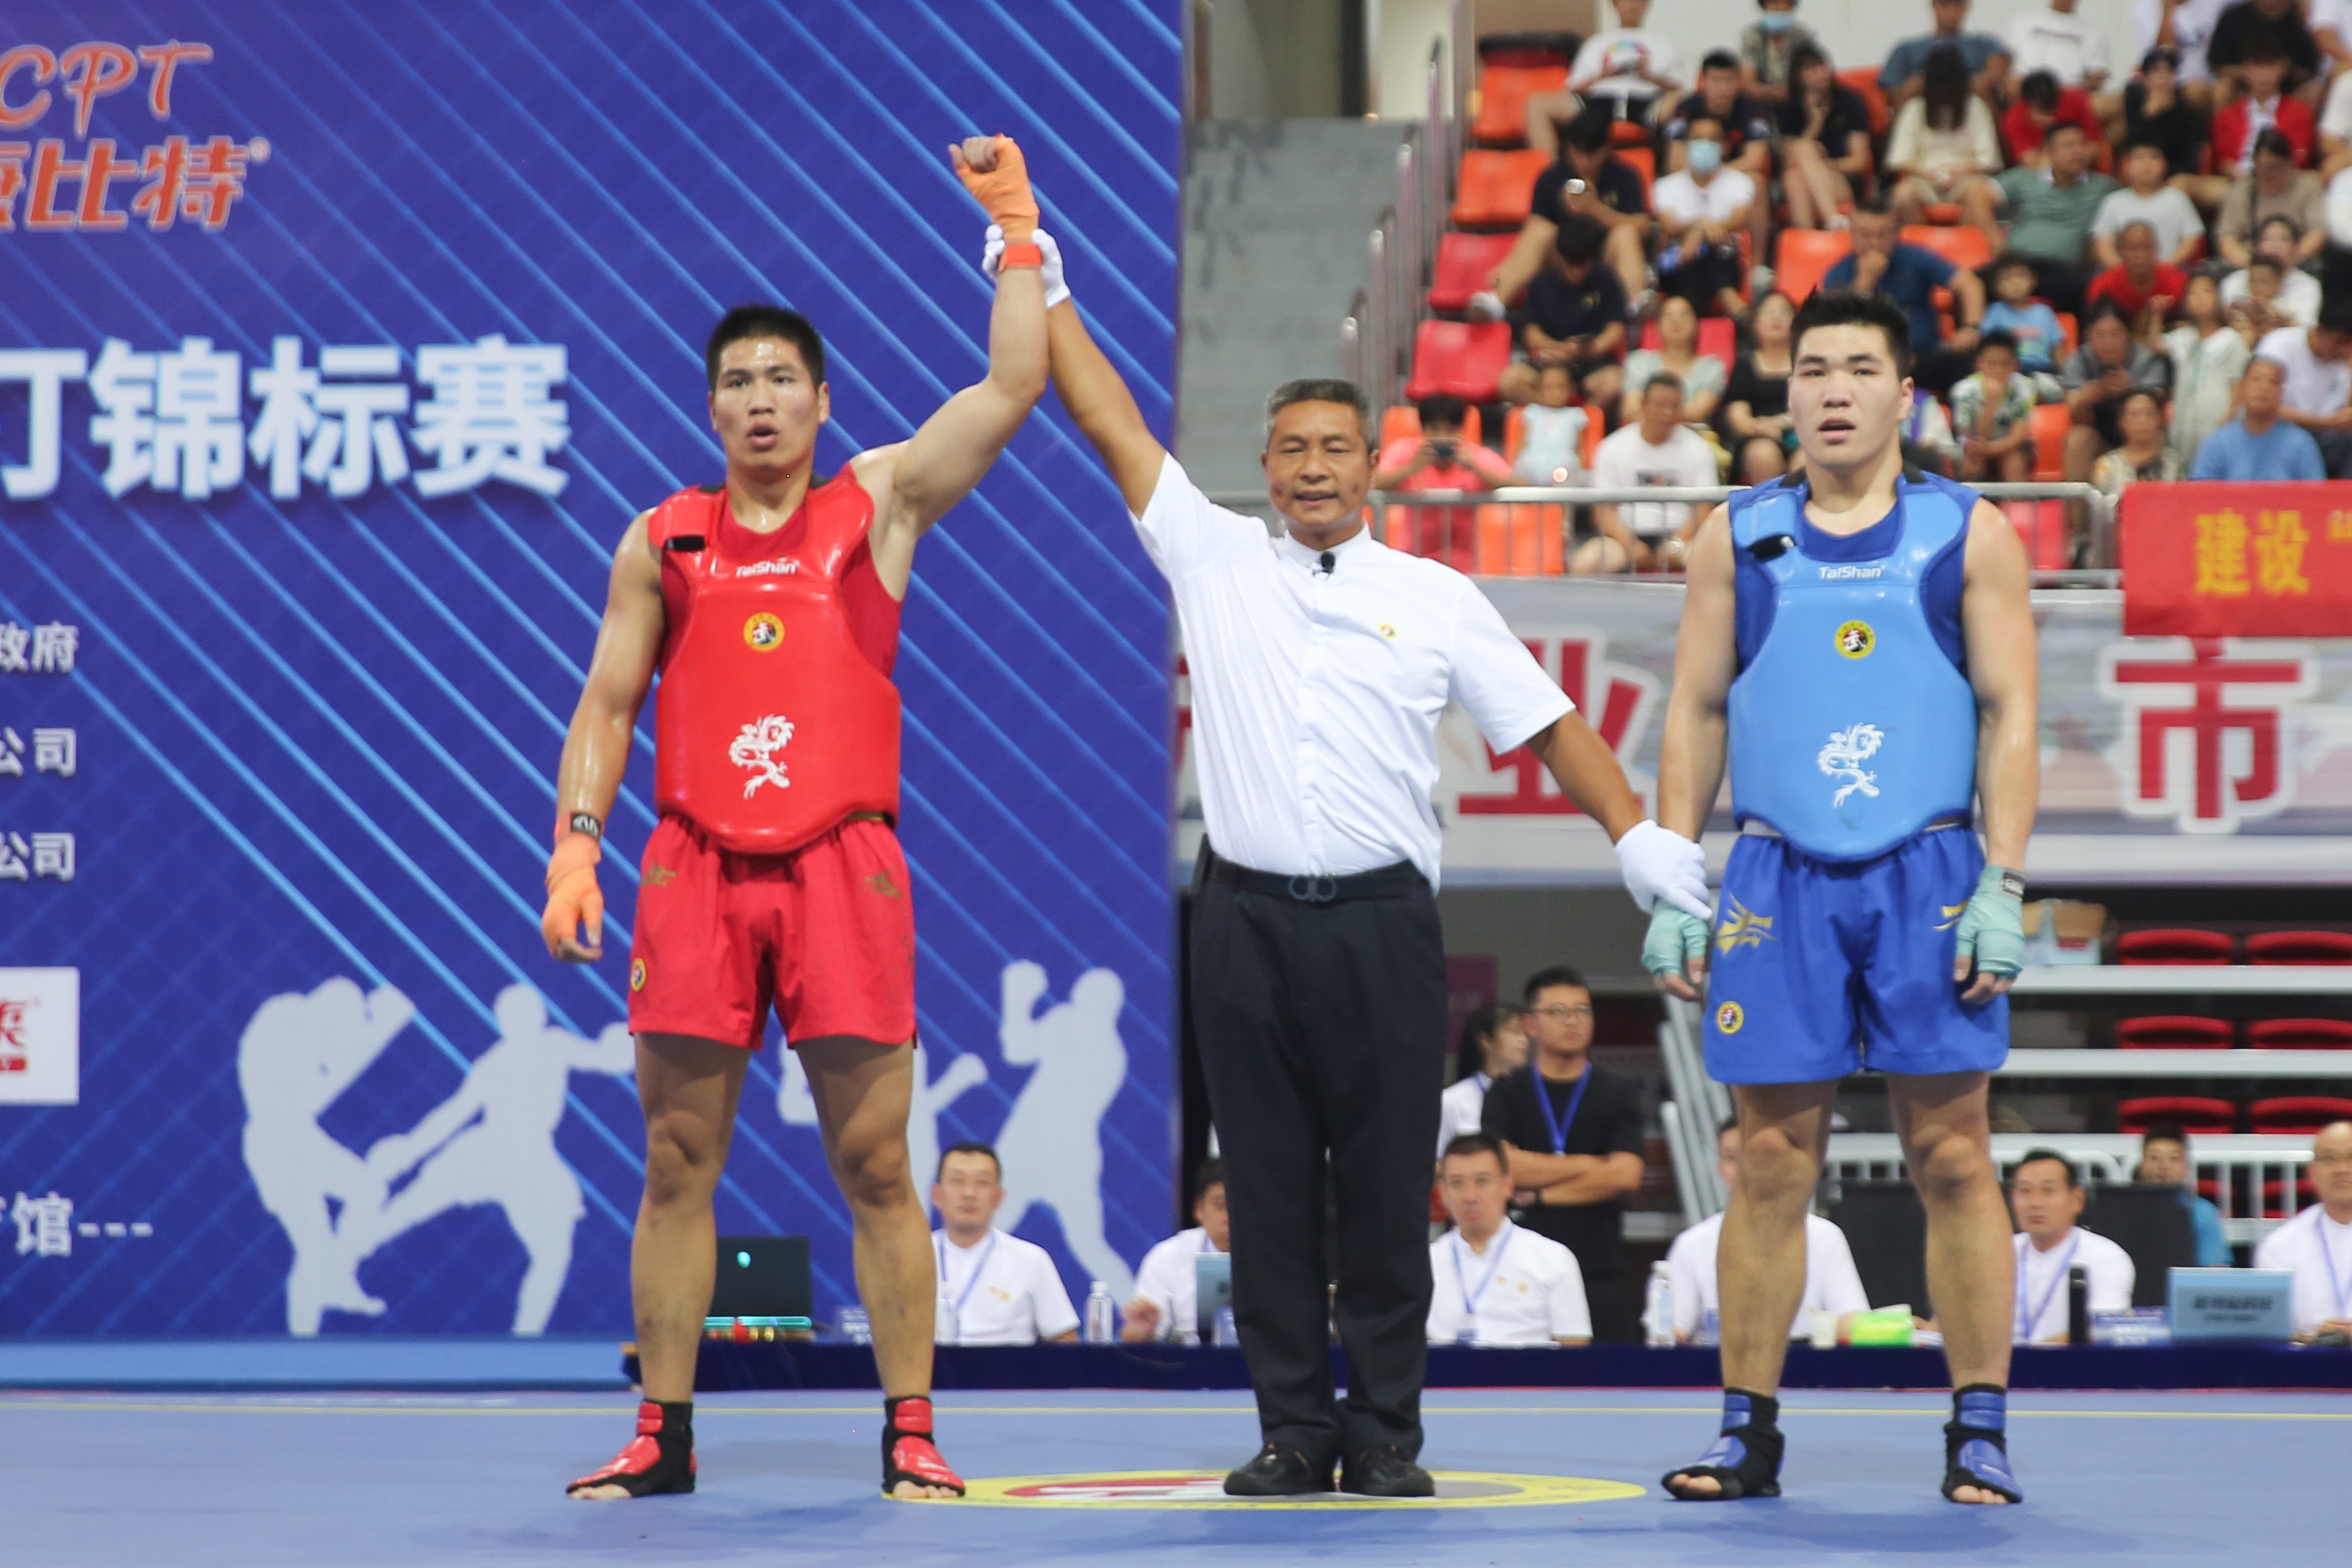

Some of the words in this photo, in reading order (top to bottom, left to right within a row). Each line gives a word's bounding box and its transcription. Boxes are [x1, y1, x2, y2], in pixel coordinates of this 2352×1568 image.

[0, 41, 213, 139] CPT
[1819, 565, 1882, 579] TaiShan
[2115, 637, 2303, 820] 市
